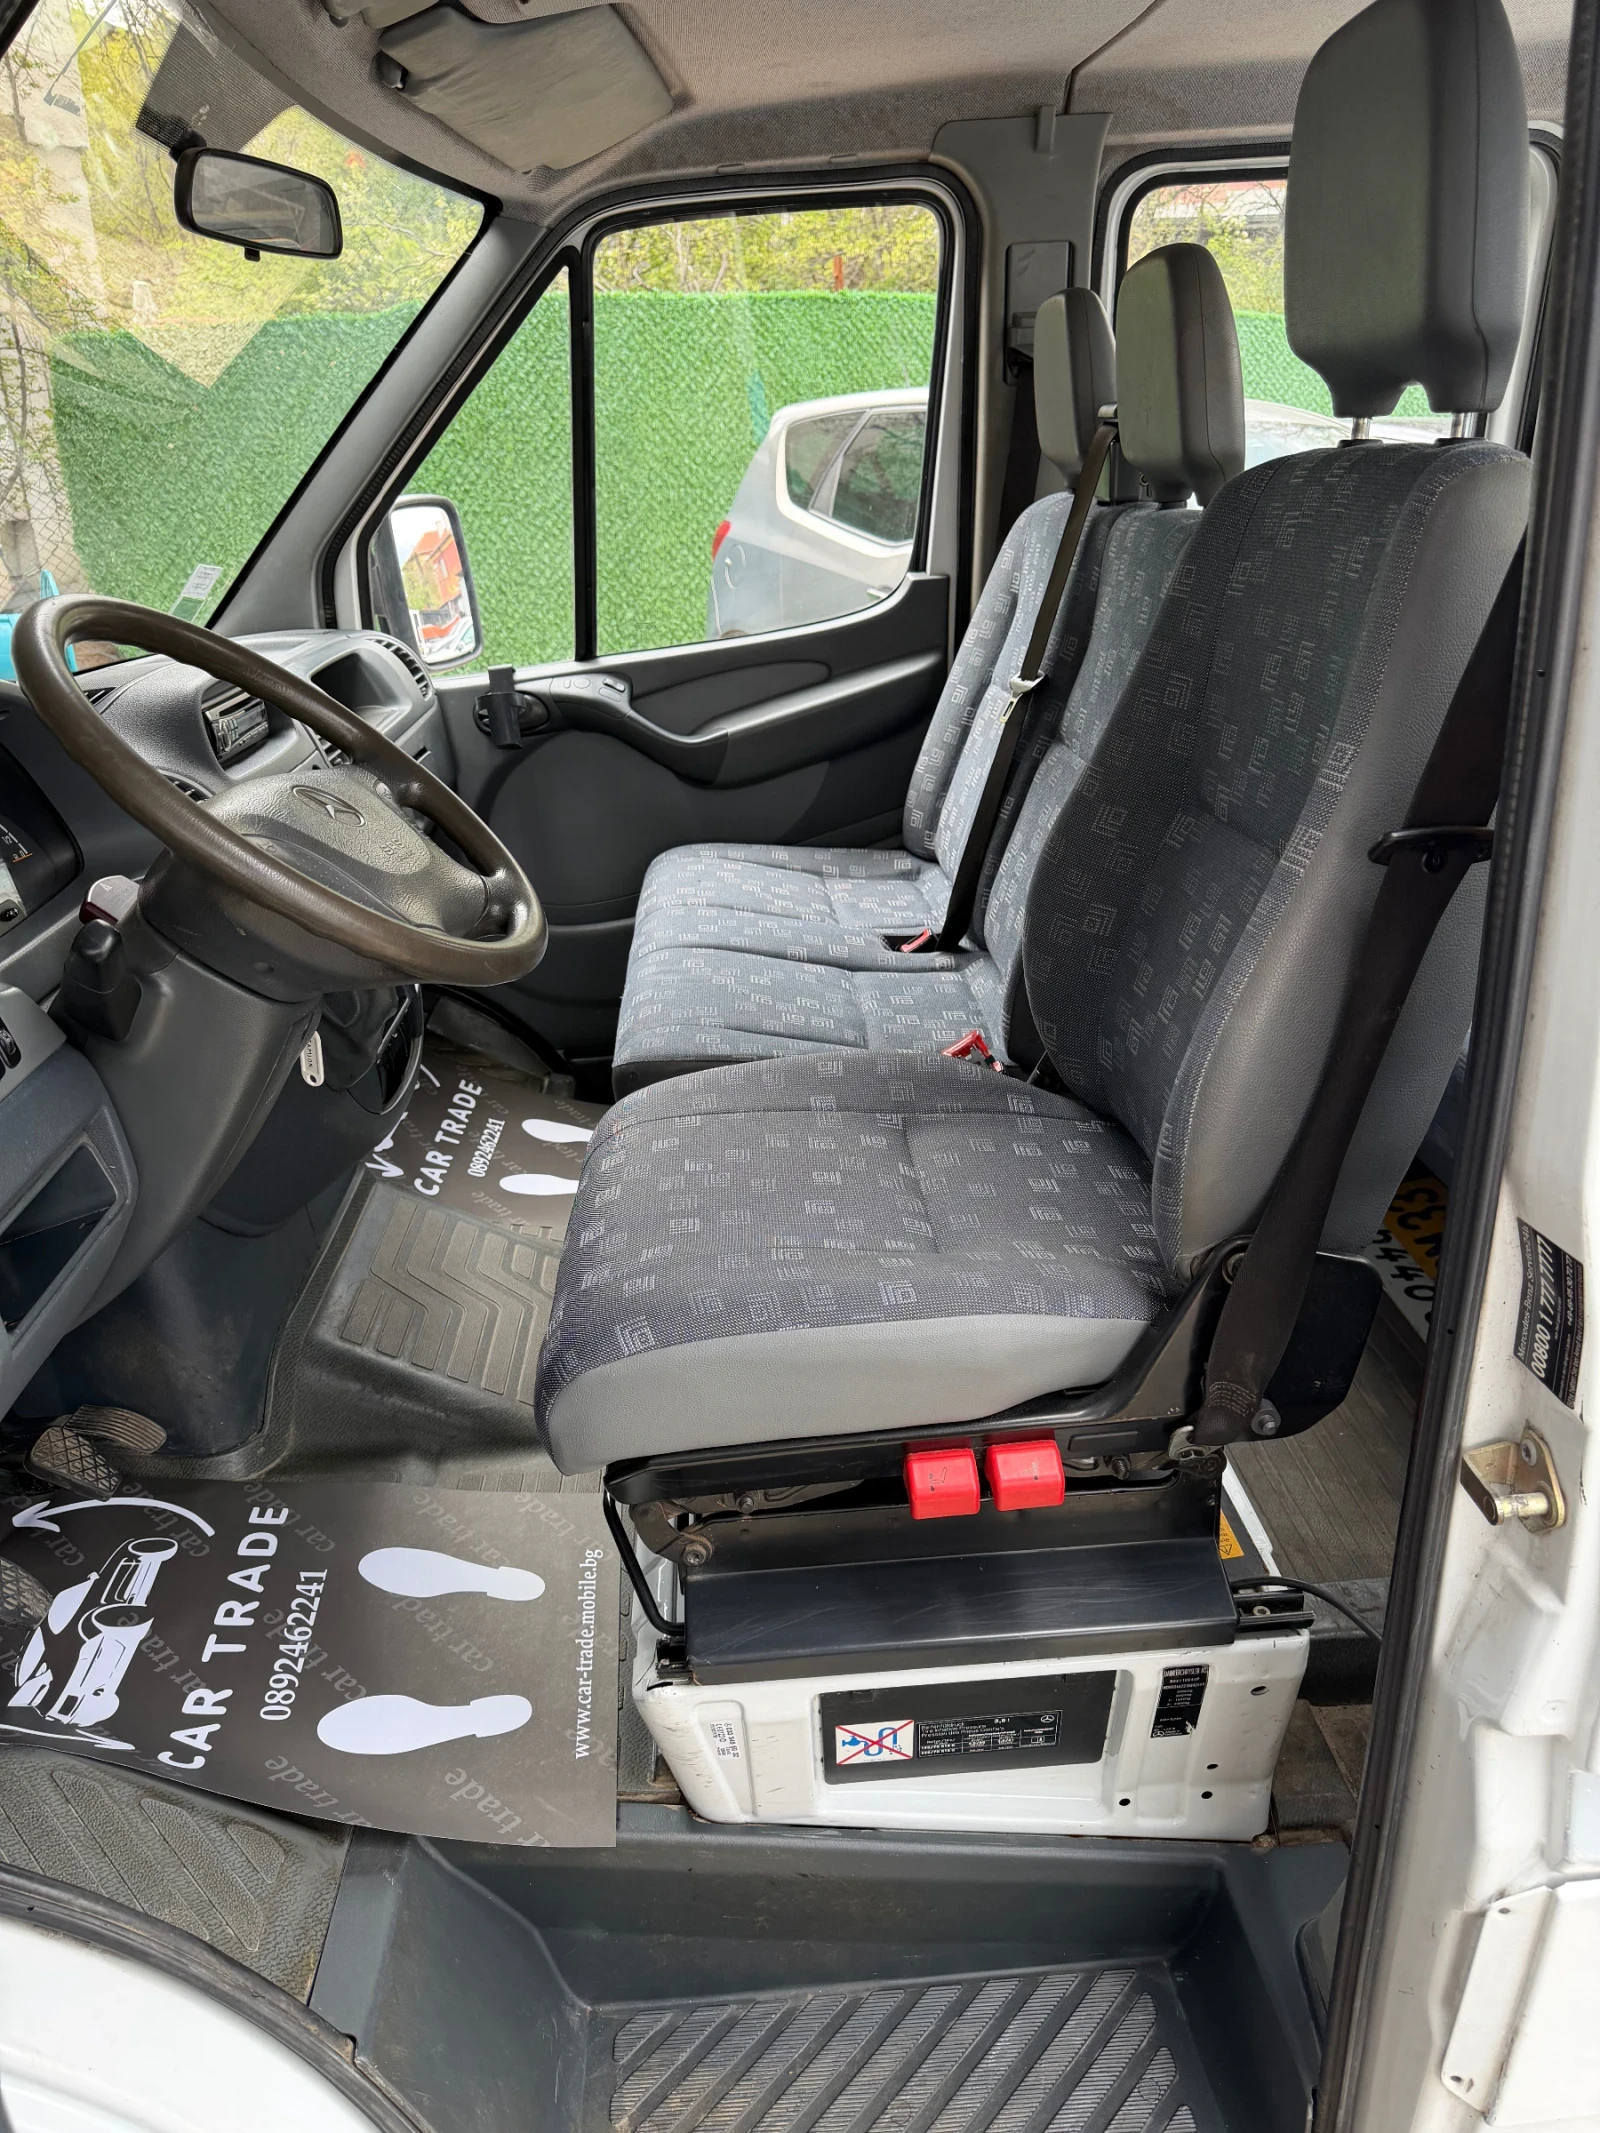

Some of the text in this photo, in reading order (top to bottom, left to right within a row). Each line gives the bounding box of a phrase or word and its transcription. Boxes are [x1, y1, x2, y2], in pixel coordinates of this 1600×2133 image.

[414, 1079, 482, 1196] CAR TRADE
[467, 1118, 505, 1178] 0892462241
[1536, 1234, 1555, 1282] 7777
[1517, 1282, 1534, 1360] Mercedes-Benz
[1539, 1277, 1555, 1315] 777
[1531, 1323, 1552, 1379] 00800
[294, 1525, 335, 1552] car
[412, 1490, 473, 1543] trade
[515, 1493, 576, 1537] trade
[44, 1535, 85, 1566] car
[170, 1527, 211, 1558] car
[157, 1506, 290, 1770] CAR TRADE
[260, 1568, 328, 1721] 0892462241
[392, 1598, 493, 1672] car trad
[575, 1549, 603, 1759] www.car-trade.mobile.bg
[321, 1665, 367, 1700] car
[264, 1755, 339, 1808] trade
[444, 1767, 522, 1834] trade
